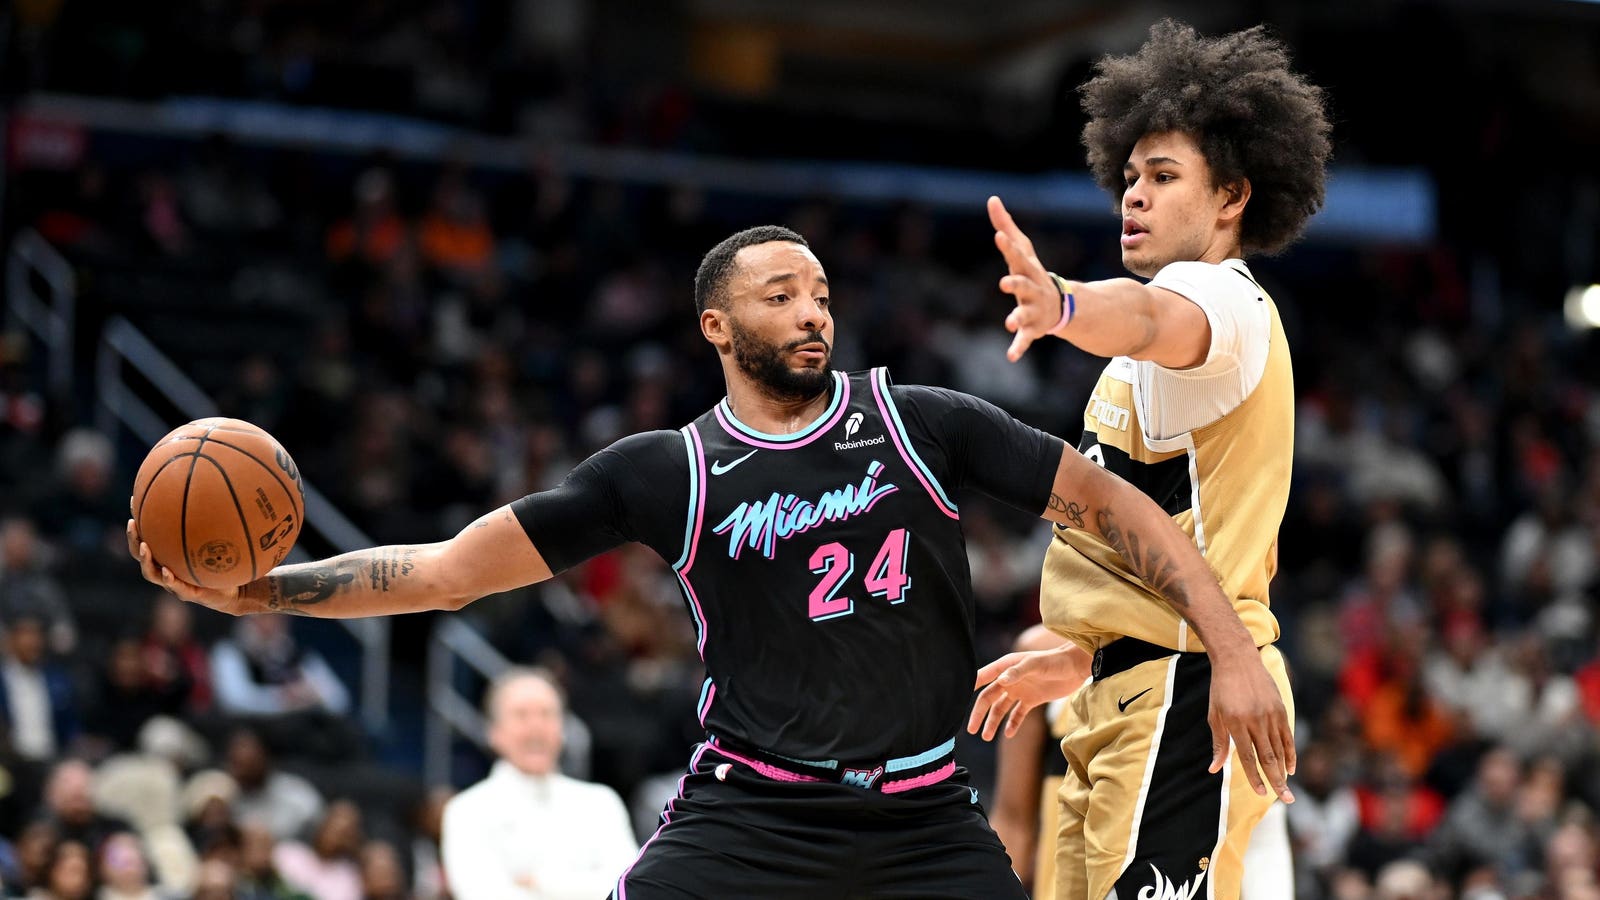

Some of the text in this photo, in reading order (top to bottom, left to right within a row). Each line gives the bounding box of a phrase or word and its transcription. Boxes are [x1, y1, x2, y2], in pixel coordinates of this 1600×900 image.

[834, 435, 885, 451] Robinhood
[712, 460, 899, 560] Miami
[808, 528, 911, 622] 24
